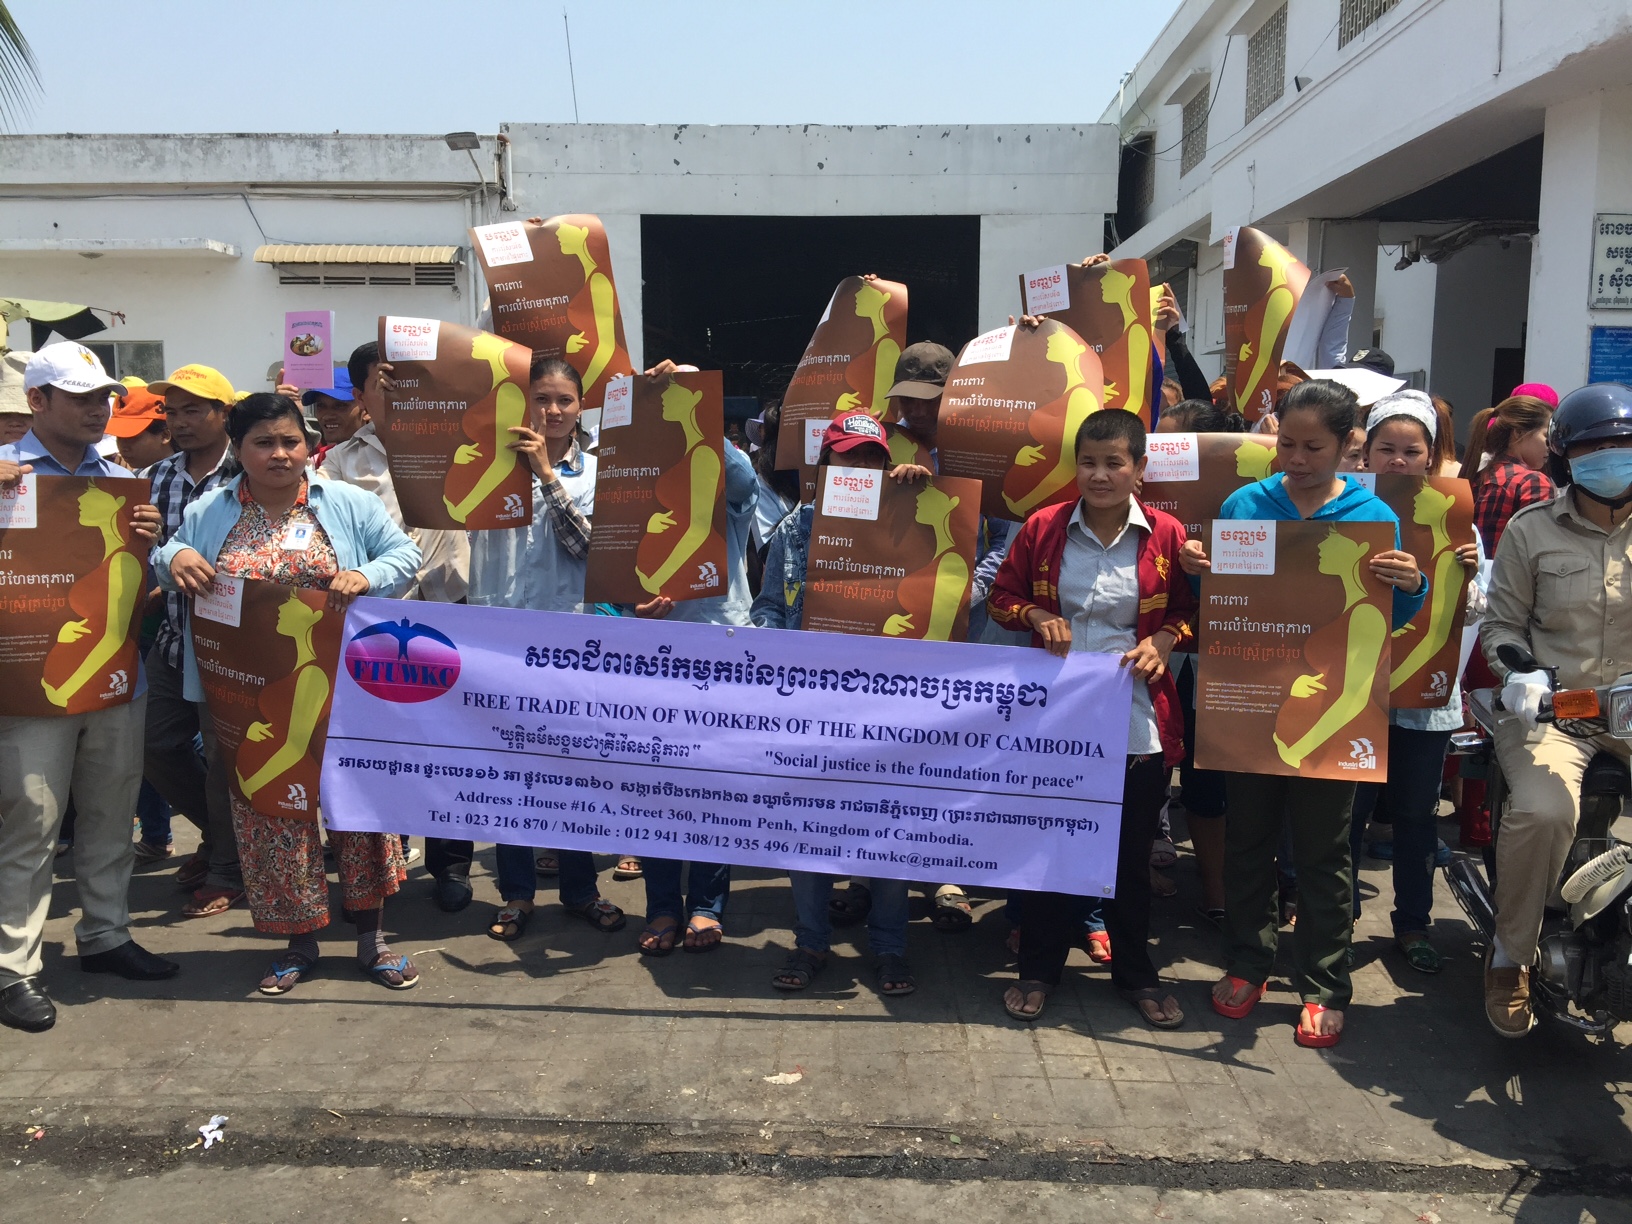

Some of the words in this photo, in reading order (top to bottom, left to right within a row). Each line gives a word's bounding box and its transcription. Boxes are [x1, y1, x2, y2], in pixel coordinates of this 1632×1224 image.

[494, 280, 523, 292] ការពារ
[497, 294, 570, 314] ការលំហែមាតុភាព
[392, 323, 432, 337] បញ្ឈប់
[952, 376, 986, 387] ការពារ
[392, 397, 467, 414] ការលំហែមាតុភាព
[948, 393, 1036, 413] ការលំហែមាតុភាព
[1149, 438, 1191, 456] បញ្ឈប់
[833, 473, 874, 492] បញ្ឈប់
[818, 534, 854, 548] ការពារ
[1220, 526, 1267, 546] បញ្ឈប់
[815, 556, 906, 580] ការលំហែមាតុភាព
[813, 578, 895, 603] សំរាប់ស្ត្រីគ្រប់រូប
[1209, 593, 1249, 607] ការពារ
[1208, 616, 1311, 637] ការលំហែមាតុភាព
[1208, 641, 1301, 663] សំរាប់ស្ត្រីគ្រប់រូប
[353, 659, 455, 688] FTUWKC
[463, 691, 510, 711] FREE
[516, 696, 580, 716] TRADE
[586, 701, 648, 721] UNION
[652, 707, 679, 723] OF
[684, 710, 781, 732] WORKERS
[786, 718, 813, 735] OF
[817, 720, 856, 738] THE
[861, 724, 960, 747] KINGDOM
[964, 732, 991, 749] OF
[995, 734, 1105, 759] CAMBODIA
[765, 750, 818, 769] "Social
[820, 755, 871, 773] justice
[875, 760, 886, 774] is
[891, 761, 915, 776] the
[918, 762, 1000, 783] foundation
[1005, 769, 1028, 785] for
[1032, 774, 1084, 790] peace"
[1358, 755, 1376, 769] all
[454, 790, 513, 807] Address
[570, 800, 596, 814] #16
[600, 803, 616, 817] A,
[620, 804, 664, 819] Street
[667, 808, 697, 825] 360,
[701, 812, 752, 829] Phnom
[757, 817, 798, 833] Penh,
[802, 820, 870, 838] Kingdom
[874, 827, 891, 839] of
[893, 828, 974, 847] Cambodia.
[428, 810, 450, 823] Tel
[465, 813, 490, 826] 023
[493, 815, 519, 828] 216
[523, 817, 548, 831] 870
[561, 821, 612, 837] Mobile
[624, 826, 650, 840] 012
[654, 829, 678, 843] 941
[683, 832, 730, 848] 308/12
[734, 838, 760, 851] 935
[764, 839, 789, 853] 496
[793, 842, 842, 858] /Email
[856, 848, 998, 870] ftuwkc@gmail.com
